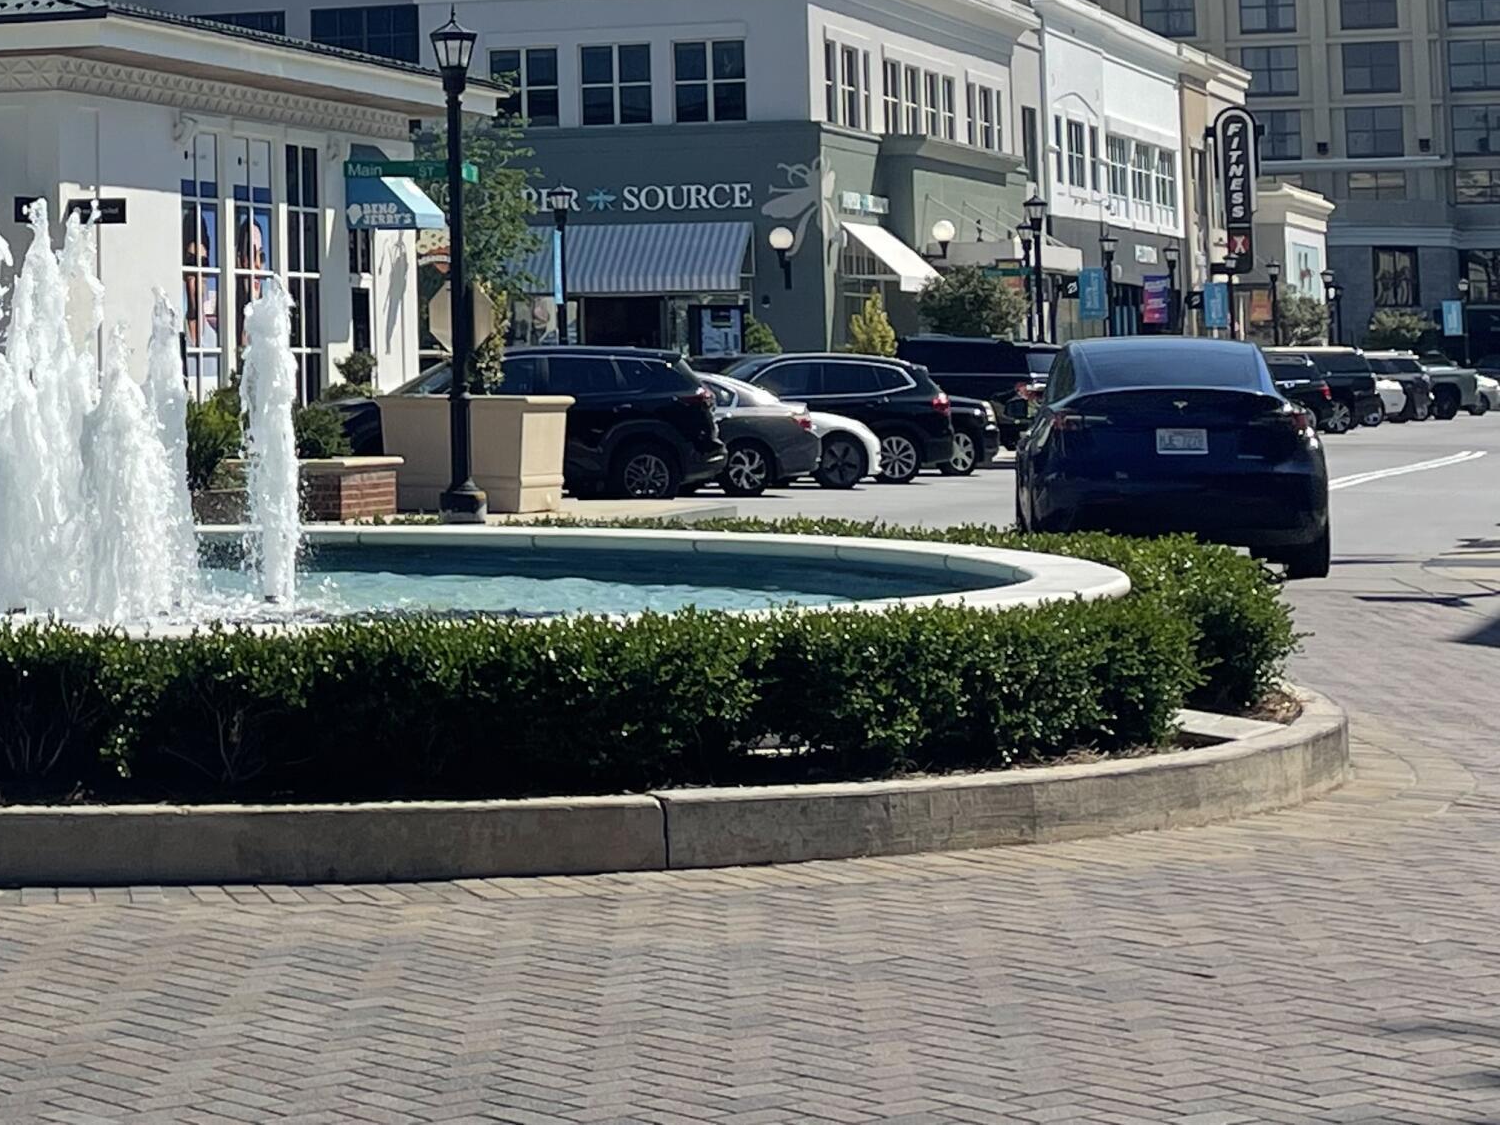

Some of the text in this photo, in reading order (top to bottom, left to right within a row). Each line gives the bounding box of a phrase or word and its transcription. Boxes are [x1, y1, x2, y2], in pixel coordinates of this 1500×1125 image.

[347, 163, 383, 176] Main
[1226, 123, 1245, 218] FITNESS
[622, 183, 753, 212] SOURCE
